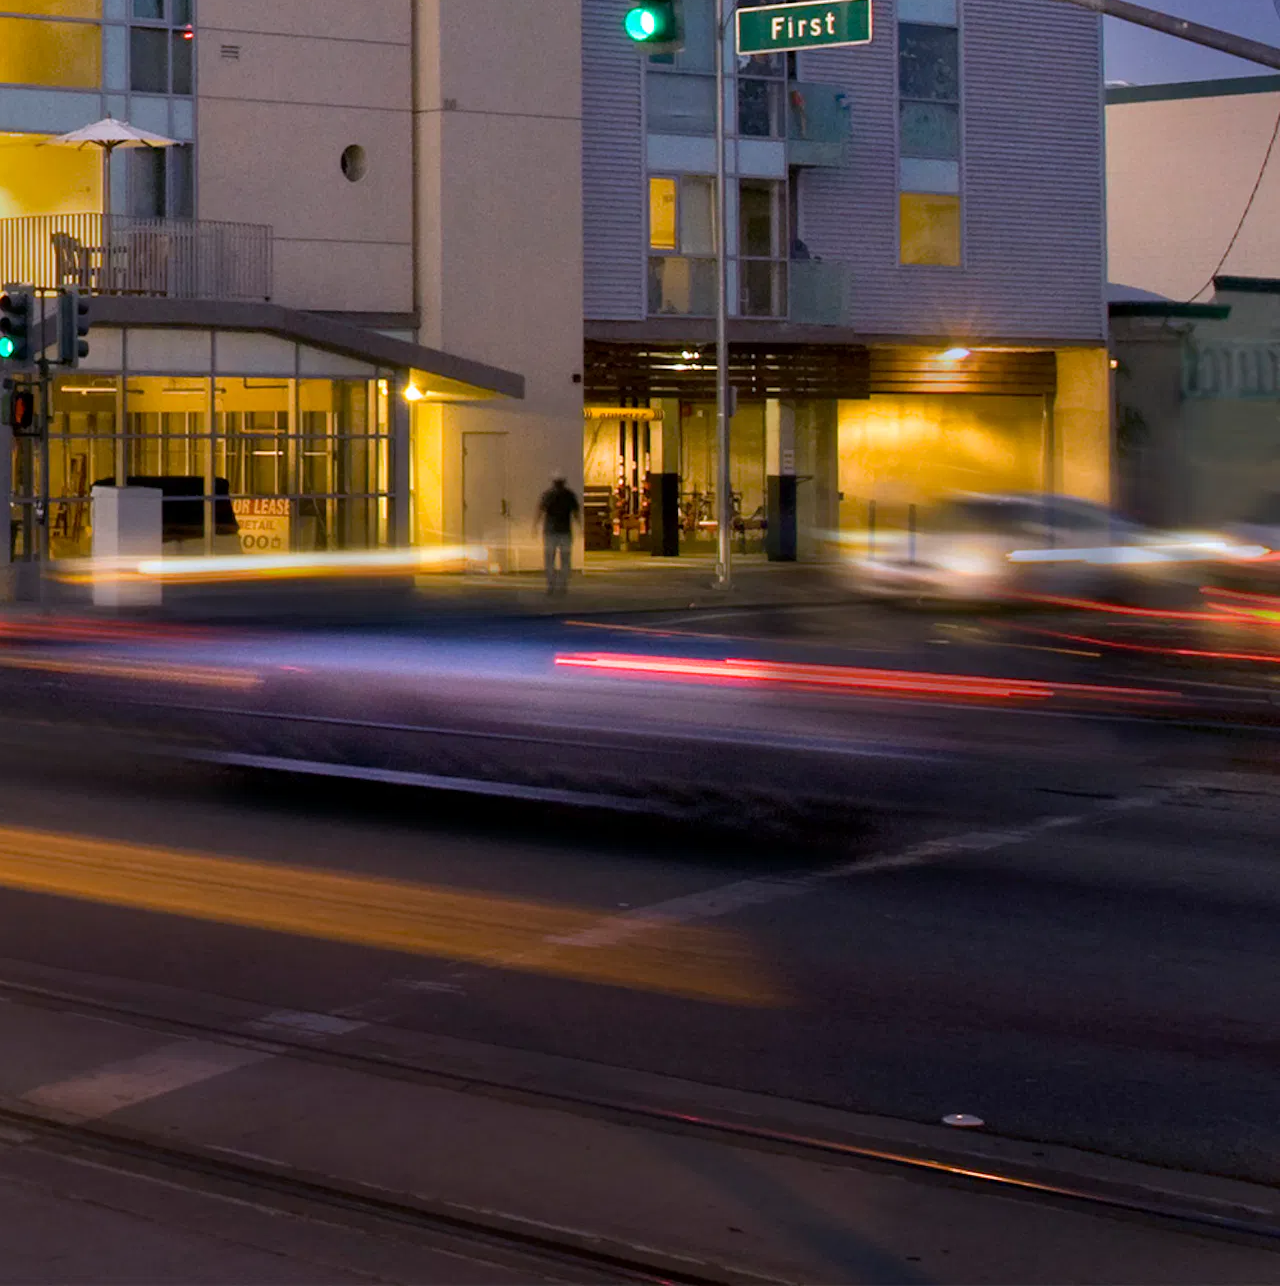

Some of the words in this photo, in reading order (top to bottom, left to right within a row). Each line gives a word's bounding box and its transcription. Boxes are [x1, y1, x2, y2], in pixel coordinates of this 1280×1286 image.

[771, 12, 835, 40] First
[233, 498, 250, 514] OR
[254, 498, 290, 515] LEASE
